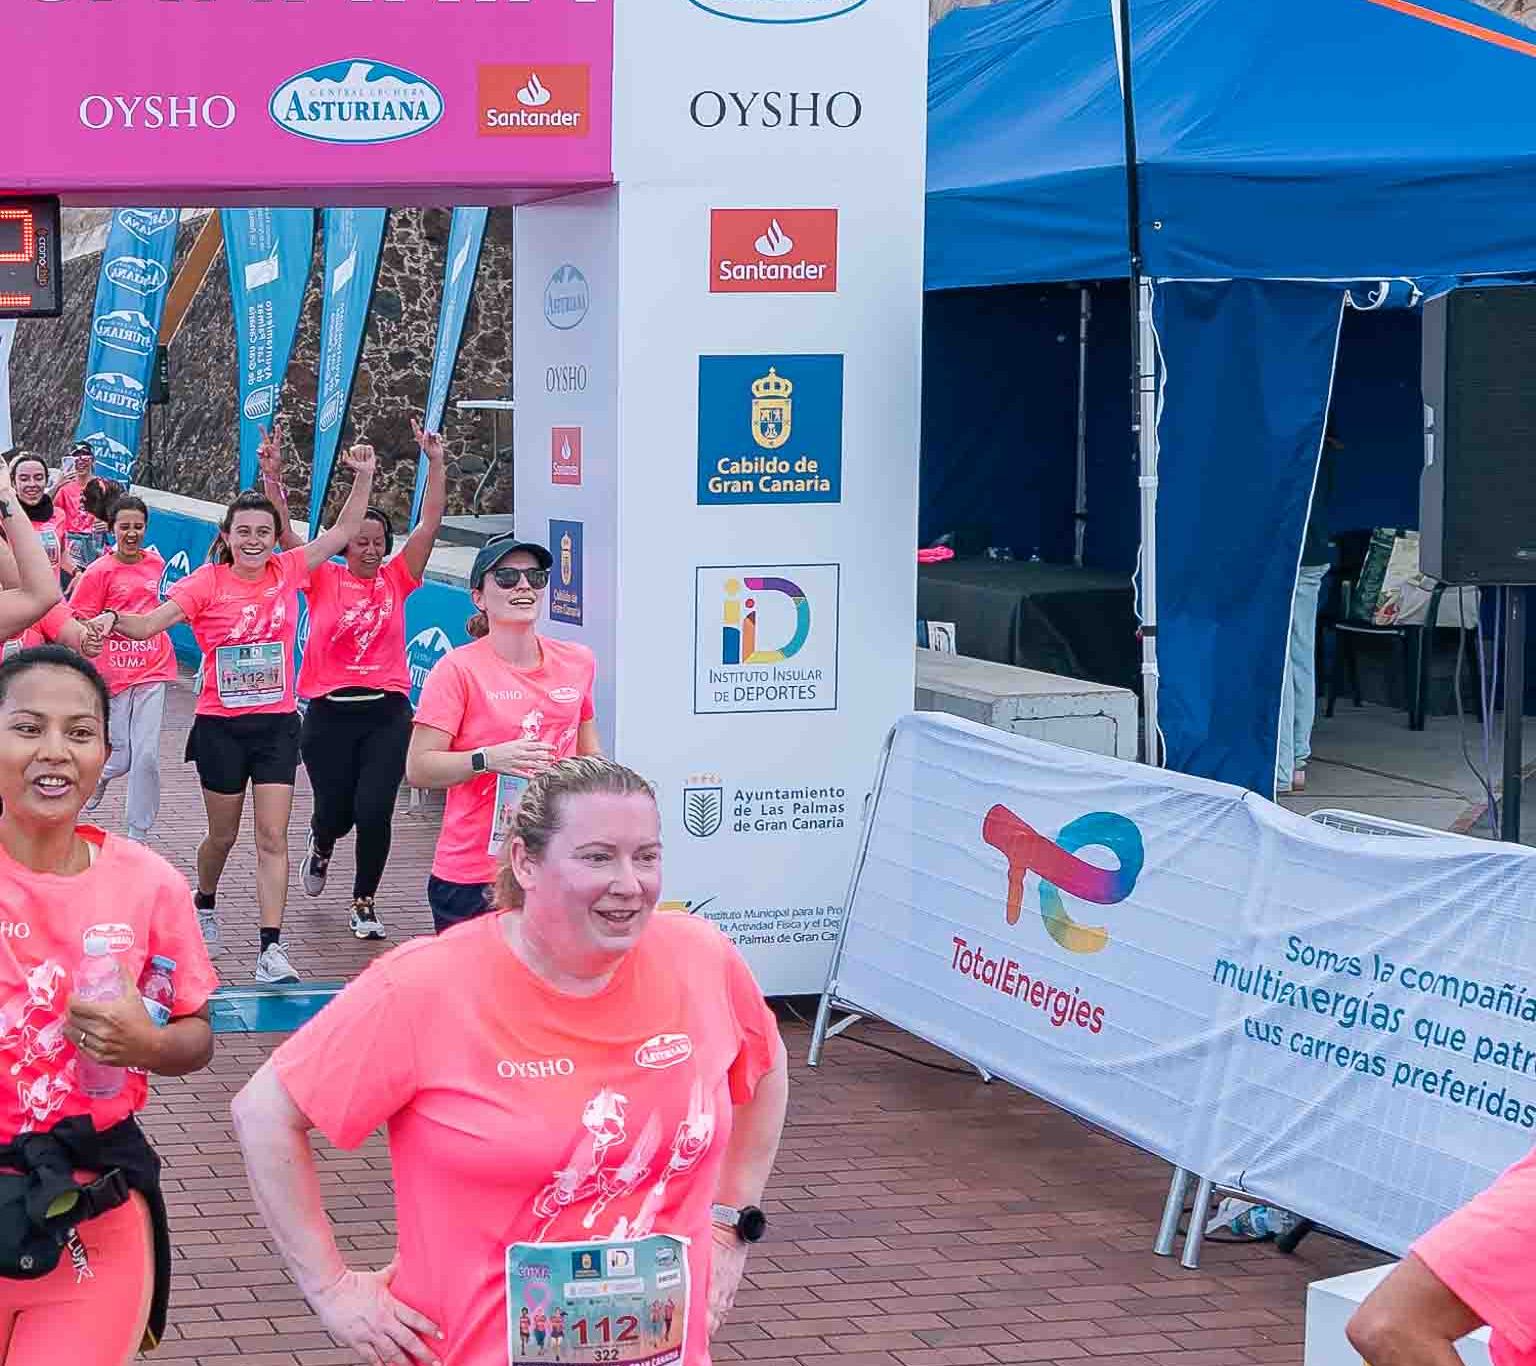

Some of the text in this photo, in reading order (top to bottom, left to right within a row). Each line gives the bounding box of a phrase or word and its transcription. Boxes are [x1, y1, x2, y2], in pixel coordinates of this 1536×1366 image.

[309, 87, 363, 99] CENTRAL
[78, 95, 237, 131] OYSHO
[283, 90, 431, 123] ASTURIANA
[690, 91, 862, 128] OYSHO
[486, 107, 581, 129] Santander
[719, 261, 826, 282] Santander
[546, 364, 587, 393] OYSHO
[717, 455, 818, 476] Cabildo de
[708, 474, 831, 495] Gran Canaria
[708, 666, 822, 684] INSTITUTO INSULAR
[714, 684, 816, 704] DE DEPORTES
[734, 786, 845, 803] Ayuntamiento
[734, 804, 845, 817] de Las Palmas
[734, 818, 845, 831] de Gran Canaria
[744, 908, 789, 920] Municipal
[792, 908, 813, 918] para
[730, 922, 774, 932] Actividad
[739, 932, 819, 945] Palmas de Gran
[1286, 933, 1360, 979] Somos
[1372, 952, 1393, 984] la
[950, 937, 1106, 1035] TotalEnergies
[1214, 955, 1467, 1057] multienergías que
[497, 1057, 575, 1080] OYSHO
[1244, 1017, 1536, 1129] tus carreras preferidas
[572, 1315, 640, 1346] 112
[594, 1349, 619, 1362] 322
